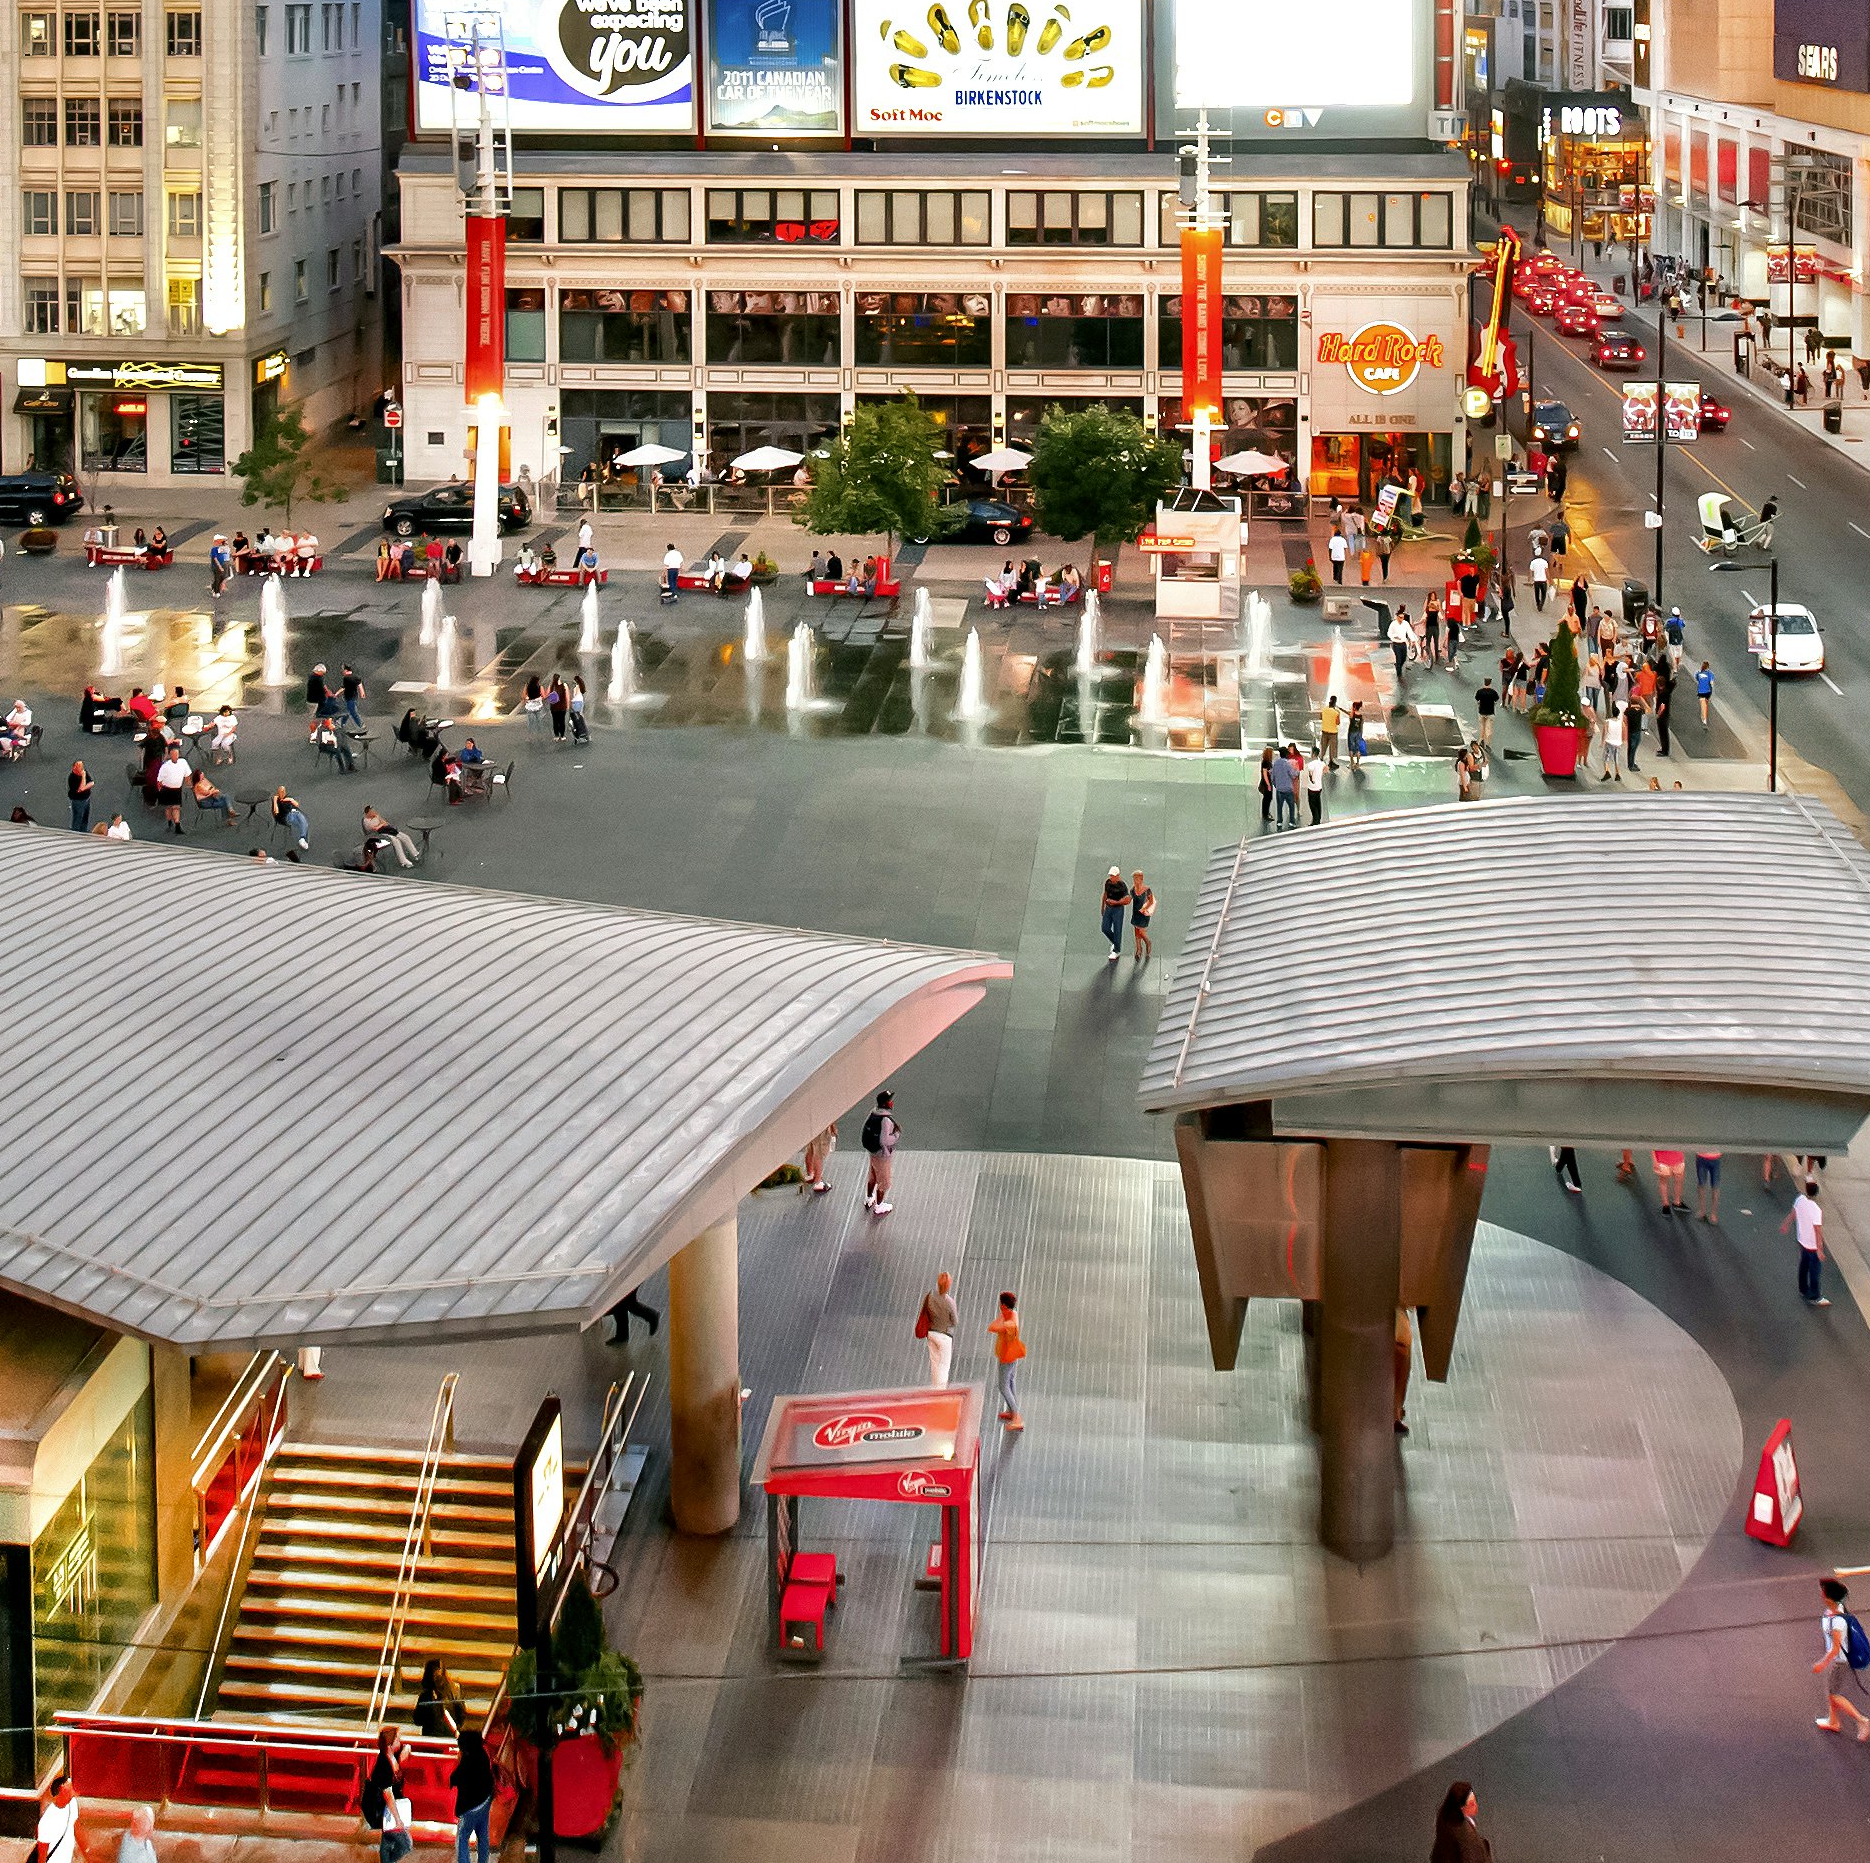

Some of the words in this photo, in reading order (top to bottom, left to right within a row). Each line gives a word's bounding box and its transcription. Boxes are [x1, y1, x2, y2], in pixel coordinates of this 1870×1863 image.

[590, 10, 684, 33] expecting
[589, 33, 673, 95] you
[1798, 44, 1838, 81] SEARS
[723, 71, 753, 86] 2011
[756, 70, 826, 86] CANADIAN
[716, 85, 744, 100] CAR
[746, 86, 766, 100] OF
[955, 90, 1042, 106] BIRKENSTOCK
[870, 108, 906, 121] Soft
[909, 108, 943, 121] Moc
[1561, 106, 1622, 136] ROOTS
[1320, 332, 1382, 363] Hard
[1385, 333, 1444, 369] Rock
[1363, 368, 1401, 381] CAFE
[1465, 390, 1489, 412] P
[1348, 414, 1373, 425] ALL
[1388, 414, 1417, 425] ONE
[825, 1417, 876, 1444] Virgin
[870, 1428, 916, 1440] mobile
